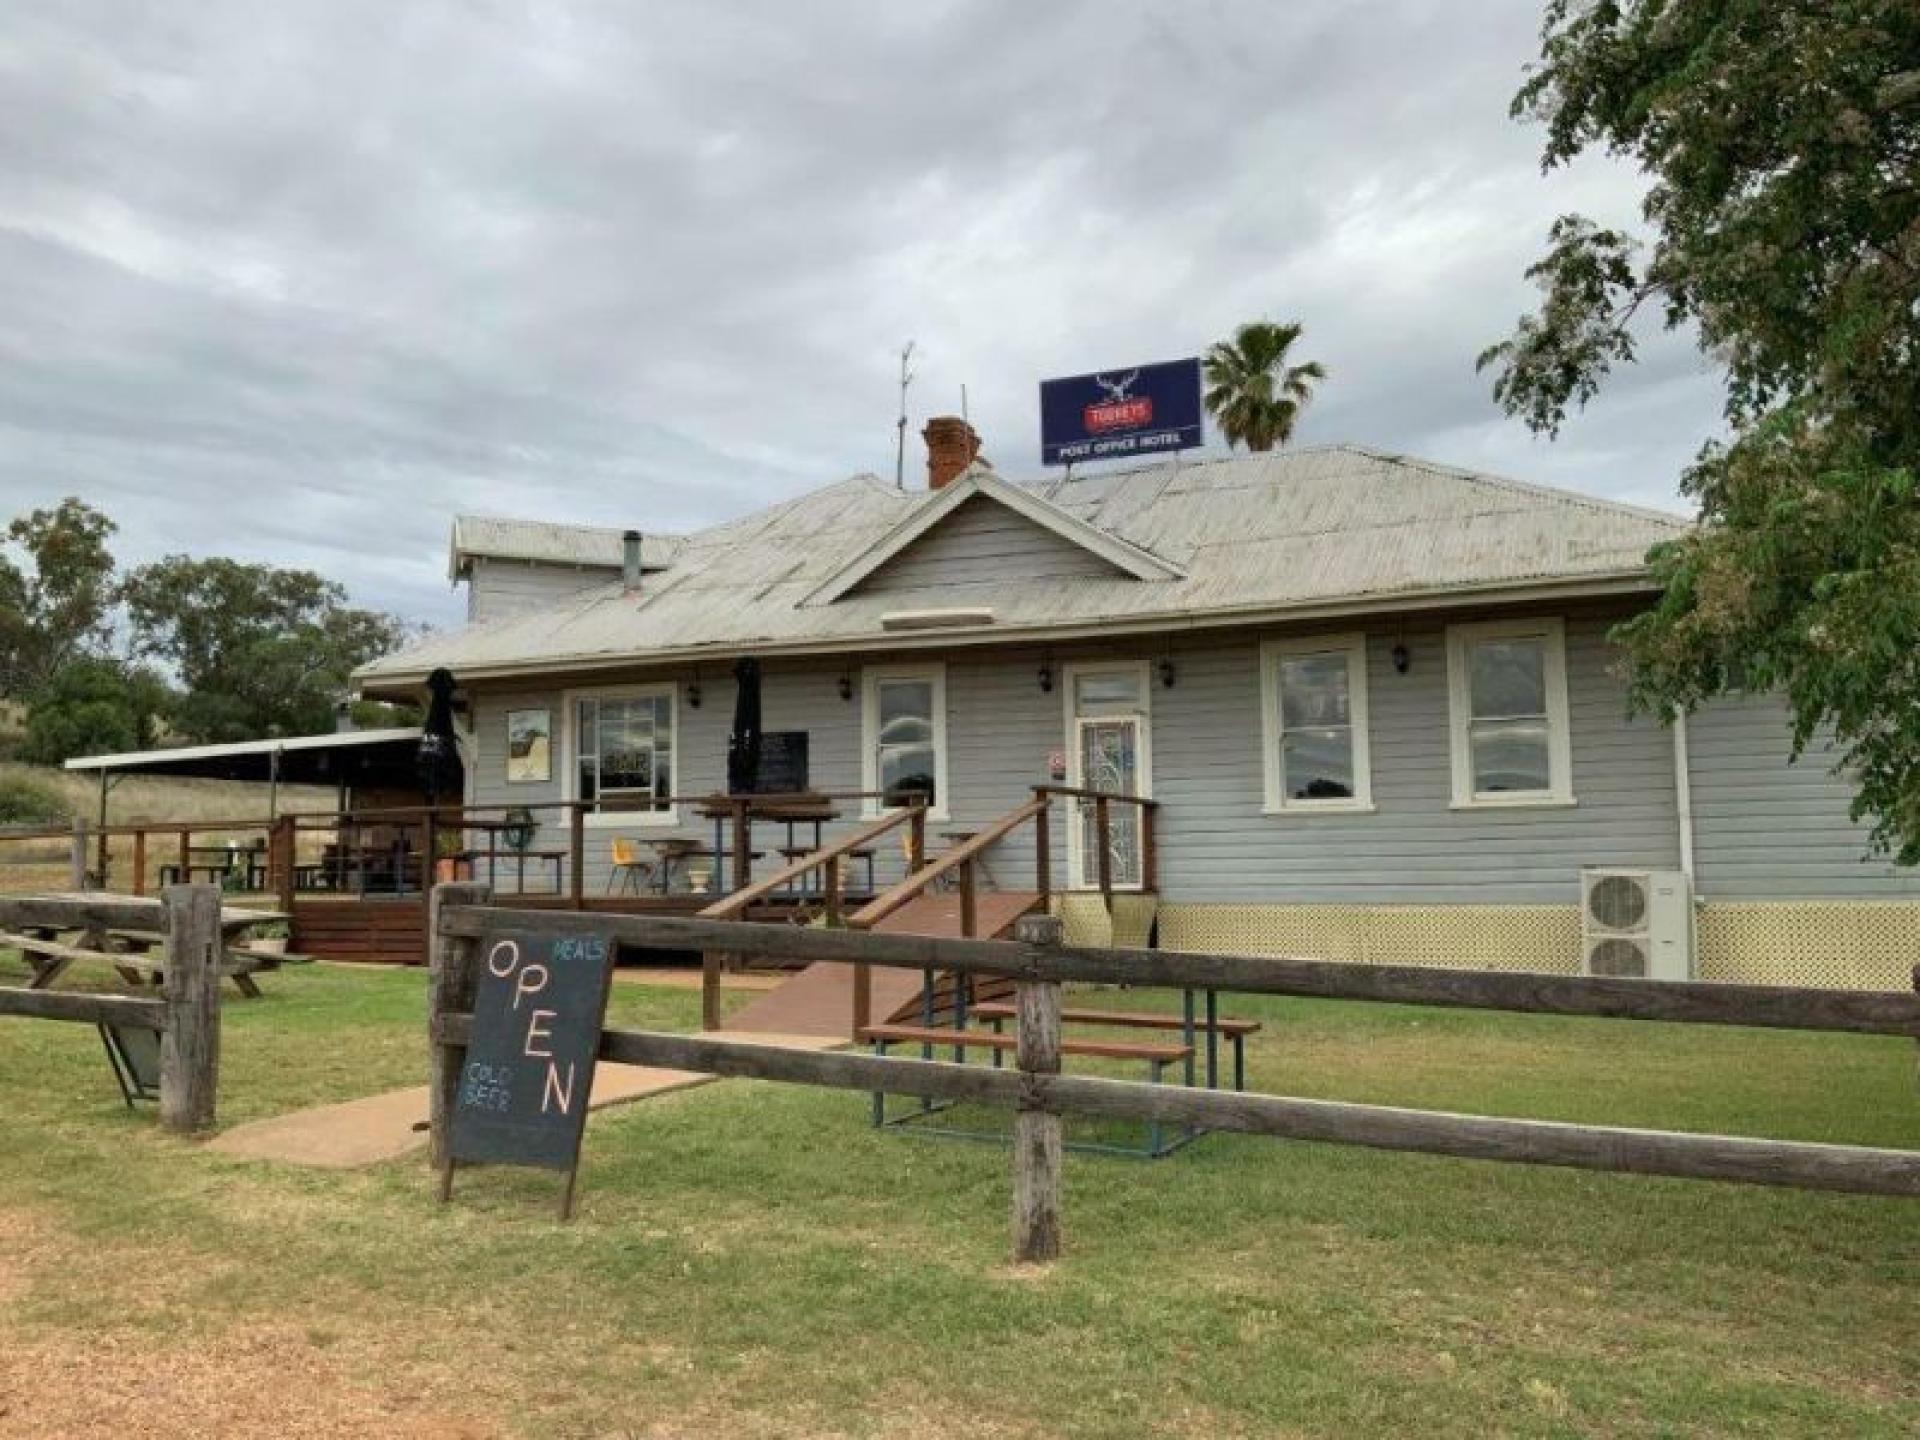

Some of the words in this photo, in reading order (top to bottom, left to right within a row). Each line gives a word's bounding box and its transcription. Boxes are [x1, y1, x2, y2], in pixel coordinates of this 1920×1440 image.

[1060, 444, 1091, 458] POST
[1094, 438, 1136, 453] OFFICE
[1139, 432, 1181, 448] HOTEL
[553, 940, 605, 961] MEALS
[489, 940, 575, 1114] OPEN
